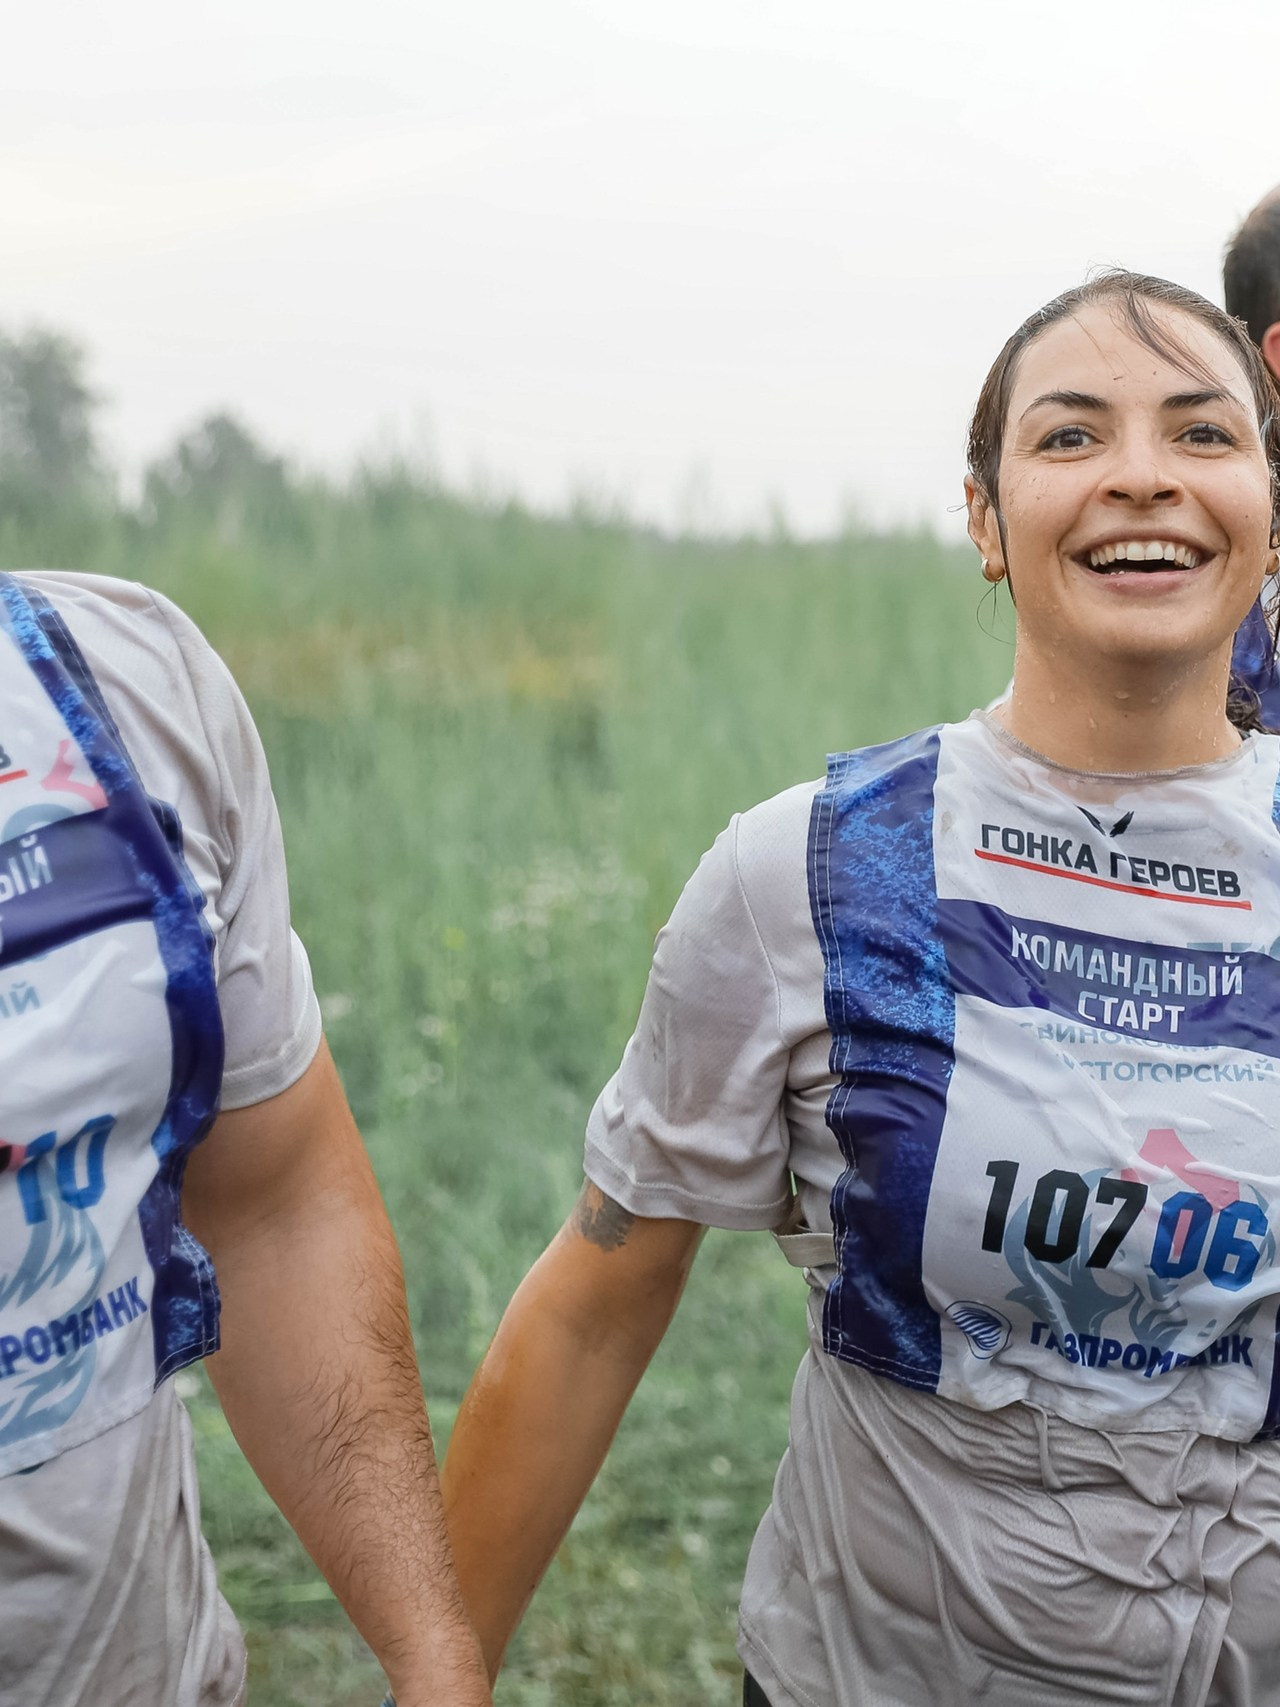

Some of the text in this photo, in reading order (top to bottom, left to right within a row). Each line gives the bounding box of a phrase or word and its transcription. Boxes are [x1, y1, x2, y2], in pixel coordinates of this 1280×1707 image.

[982, 824, 1241, 897] ГОНКА ГЕРОЕВ
[1011, 925, 1243, 998] КОМАНДНЫЙ
[1077, 990, 1185, 1033] СТАРТ
